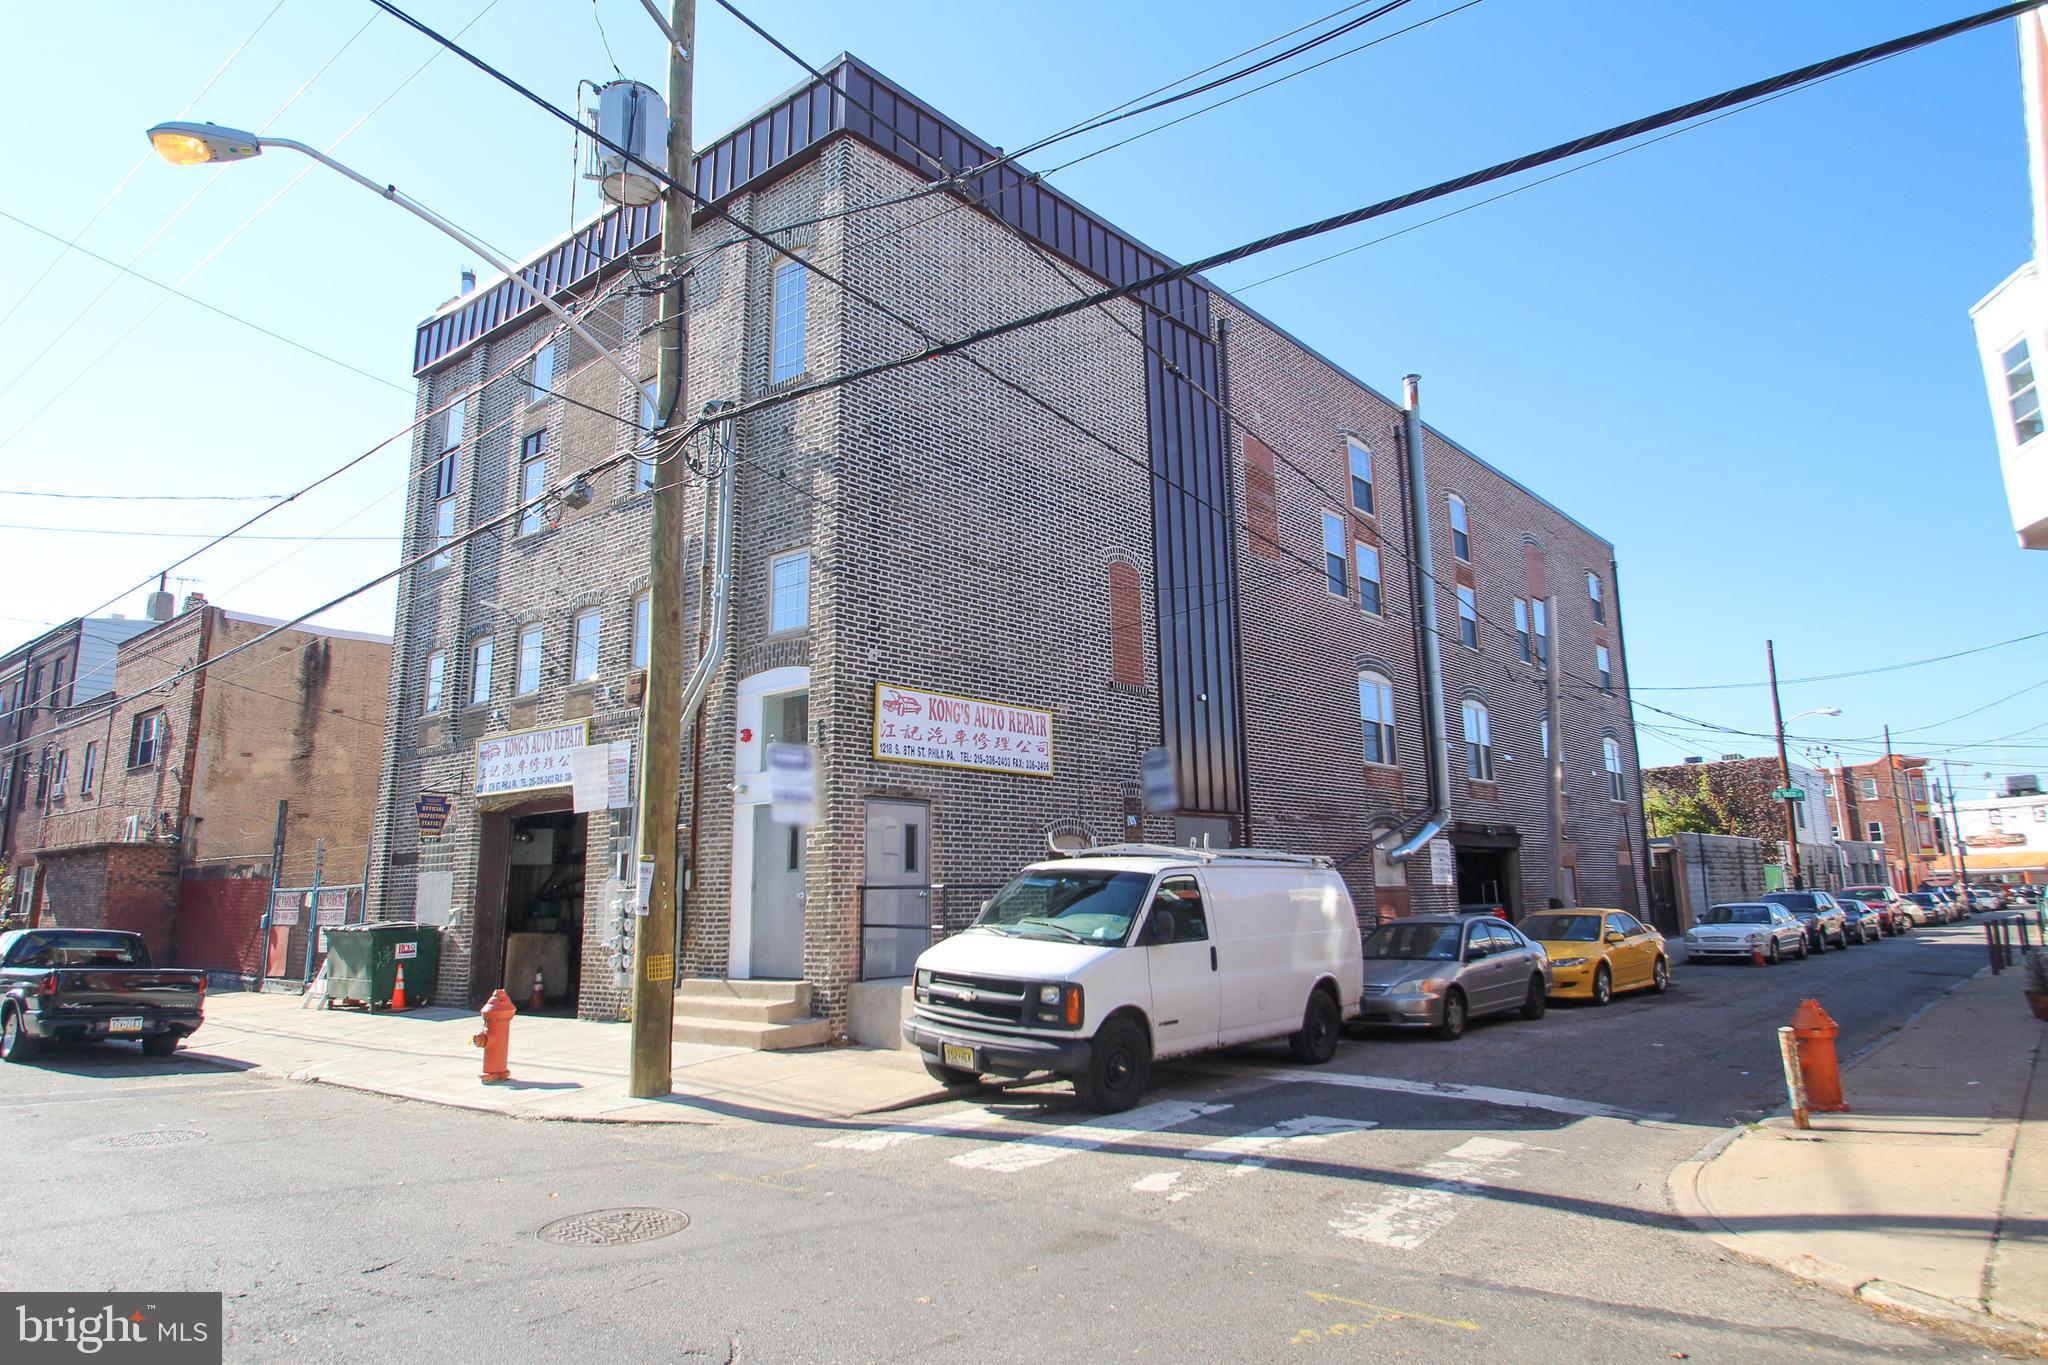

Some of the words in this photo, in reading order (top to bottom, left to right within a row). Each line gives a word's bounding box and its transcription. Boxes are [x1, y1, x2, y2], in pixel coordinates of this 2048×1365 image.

[928, 697, 970, 726] KONG'S
[974, 704, 1004, 732] AUTO
[1008, 710, 1048, 738] REPAIR
[504, 736, 530, 758] KONG'S
[530, 731, 551, 756] AUTO
[554, 726, 584, 752] REPAIR
[880, 719, 1049, 757] 江記汽車修理公司
[880, 742, 892, 754] 1218
[895, 744, 901, 754] S.
[903, 745, 915, 756] 8TH
[918, 746, 926, 757] ST.
[928, 747, 945, 760] PHILA
[946, 750, 956, 760] PA.
[960, 752, 972, 763] TEL:
[1012, 758, 1024, 769] FAX:
